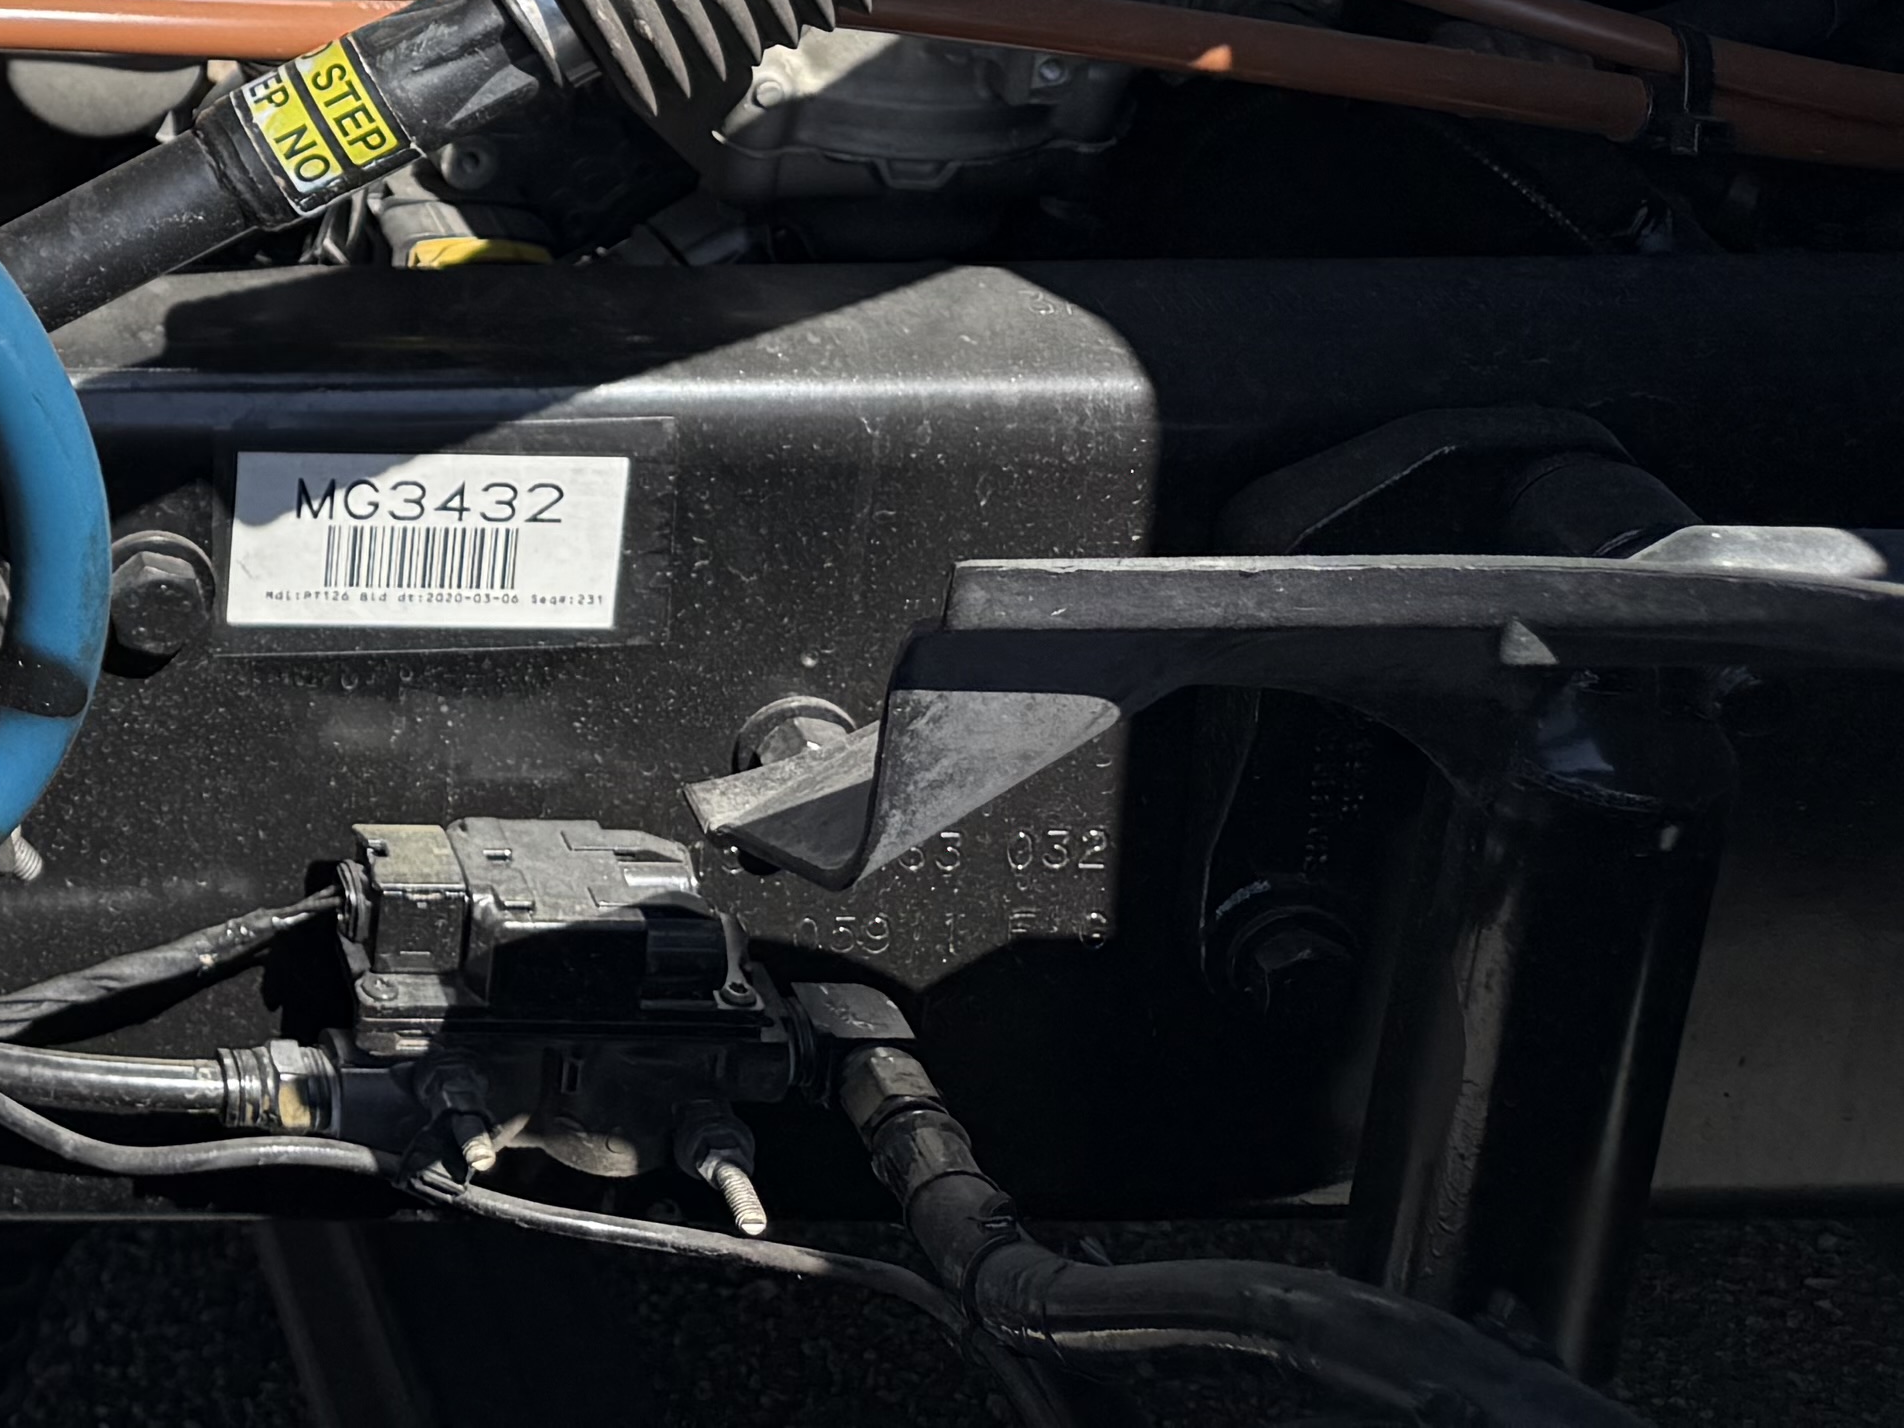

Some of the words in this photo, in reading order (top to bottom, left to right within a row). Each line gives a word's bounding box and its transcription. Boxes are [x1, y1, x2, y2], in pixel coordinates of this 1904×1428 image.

[249, 74, 291, 107] EP
[274, 124, 331, 183] NO
[311, 63, 387, 151] STEP
[296, 477, 564, 523] MG3432
[360, 593, 387, 602] Bld
[397, 593, 519, 604] dt:2020-03-06
[531, 594, 604, 605] Seq#:231
[1006, 830, 1110, 870] 032
